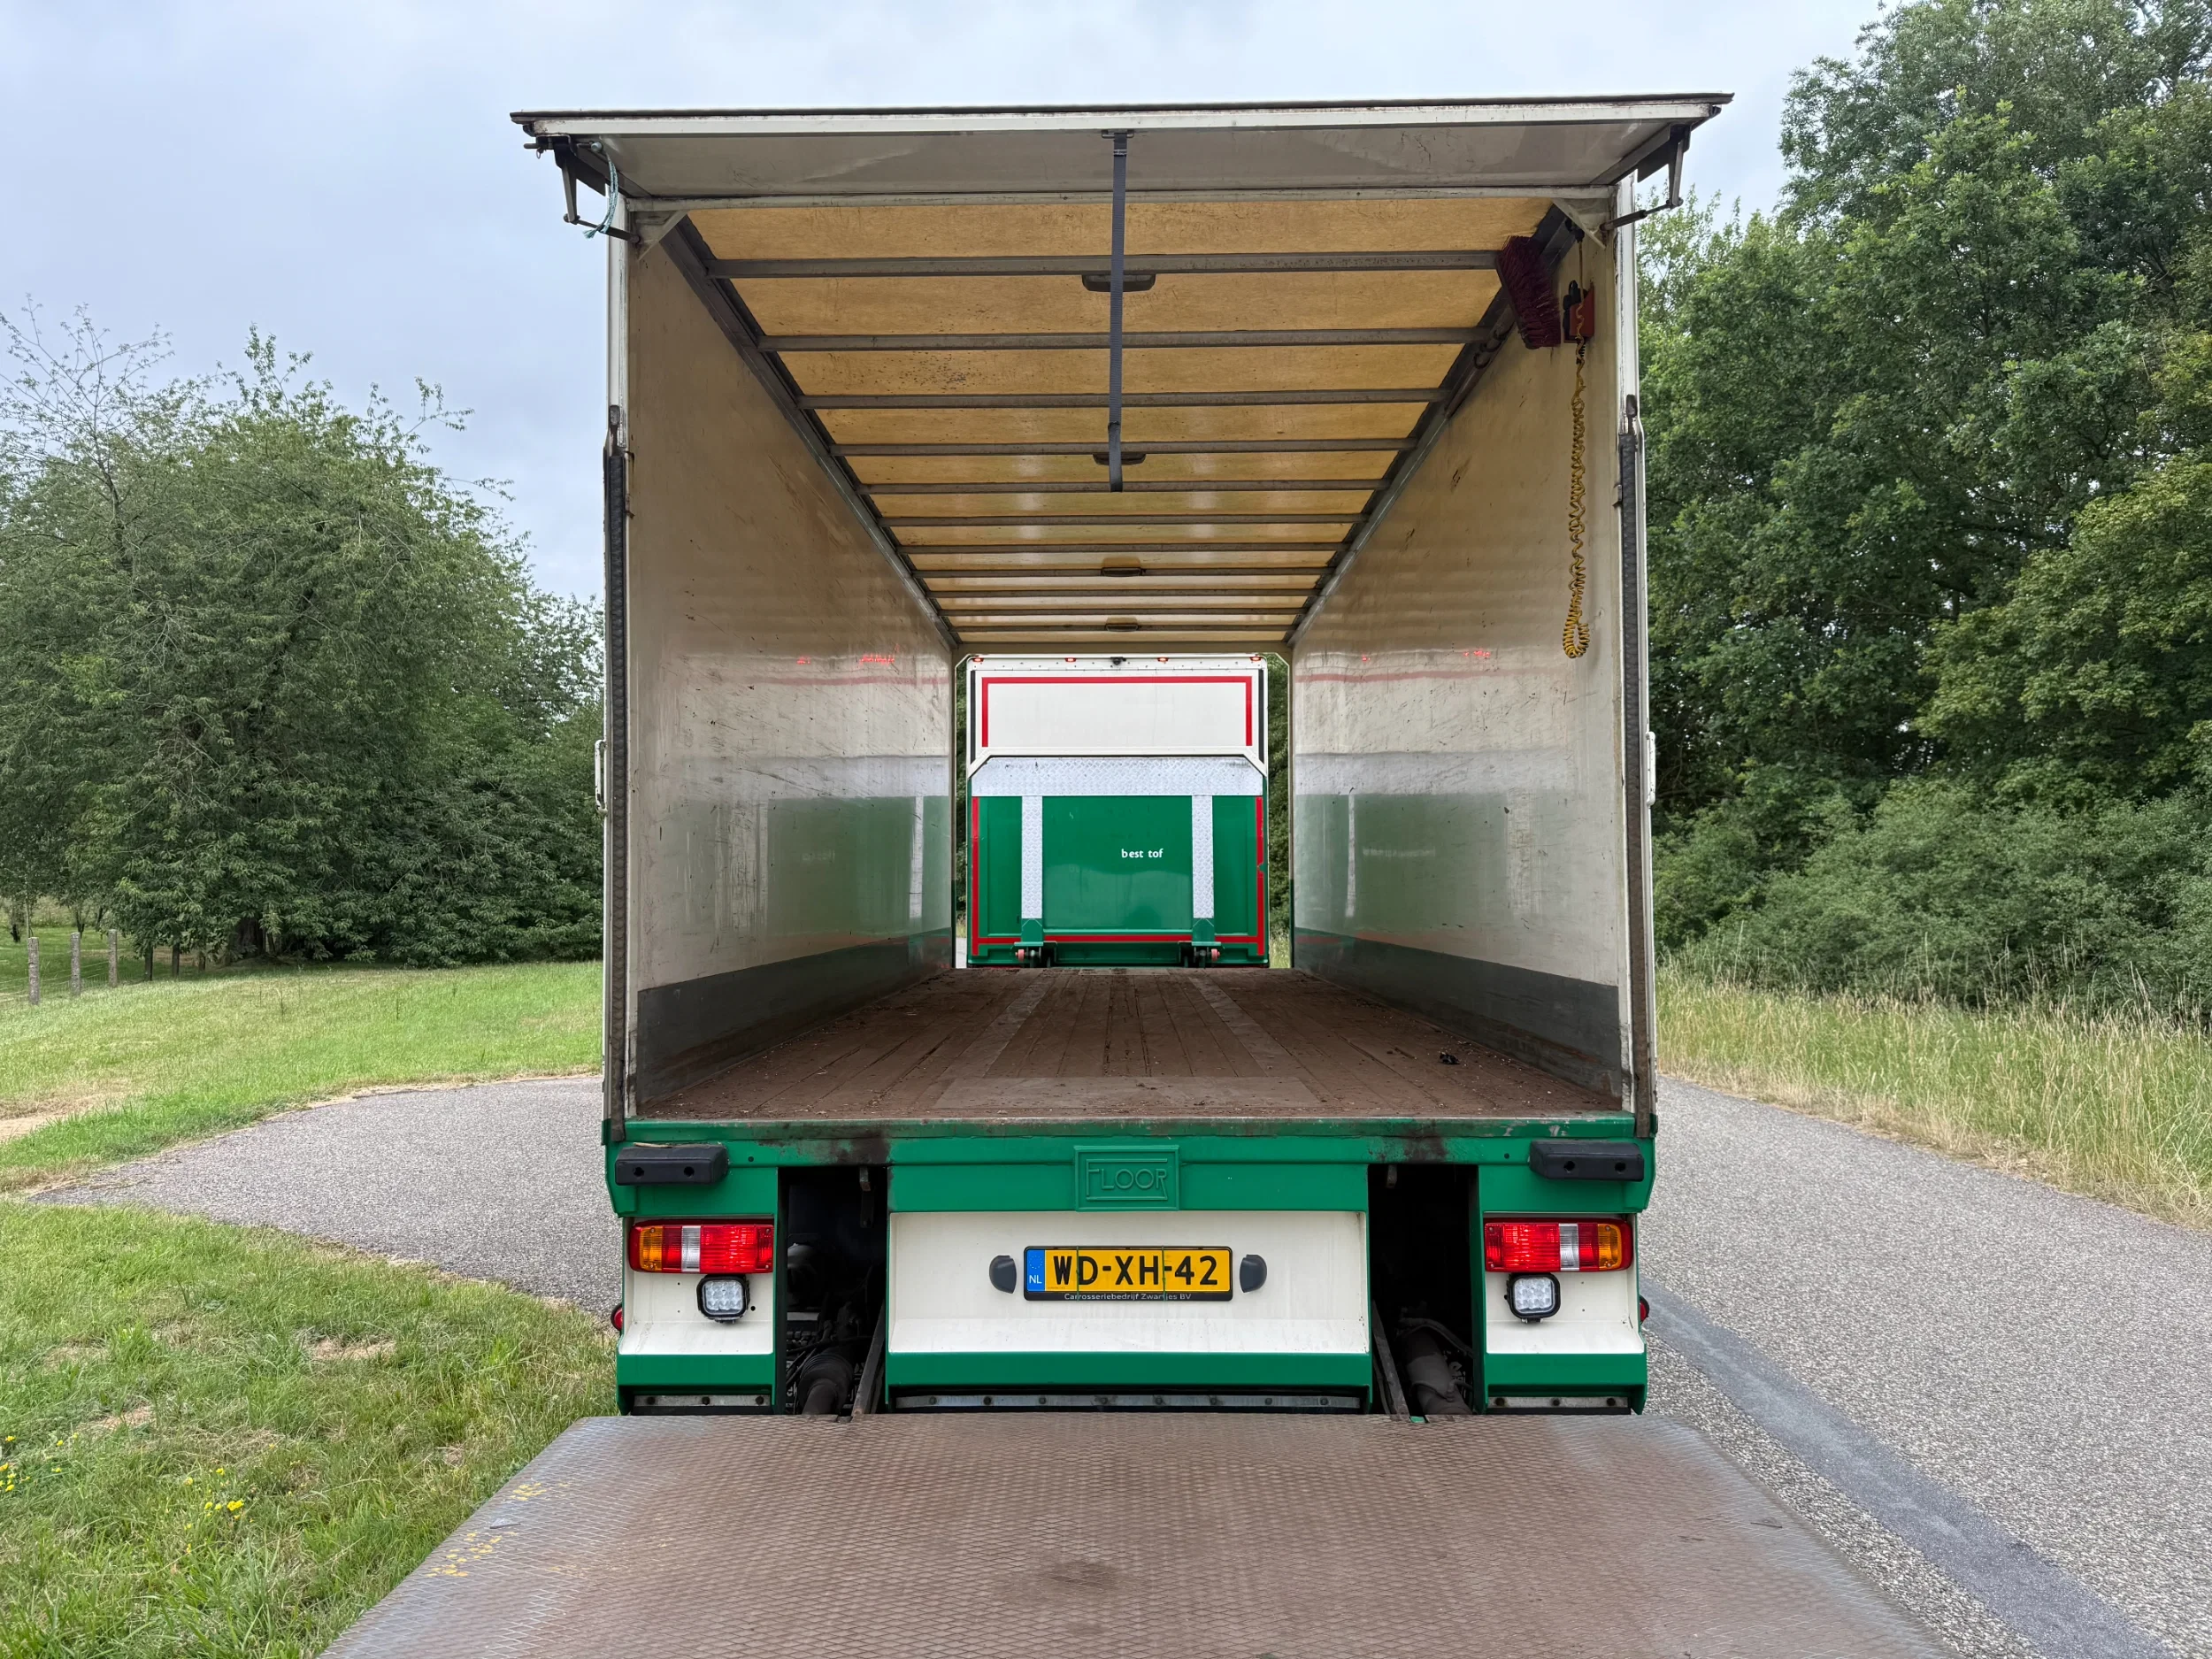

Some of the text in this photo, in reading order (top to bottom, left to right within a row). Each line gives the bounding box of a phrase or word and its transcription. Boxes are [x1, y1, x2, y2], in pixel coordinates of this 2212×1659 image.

[1121, 848, 1164, 858] best tof
[1087, 1158, 1168, 1200] FLOOR
[1029, 1274, 1042, 1284] NL
[1053, 1256, 1218, 1286] WD-XH-42
